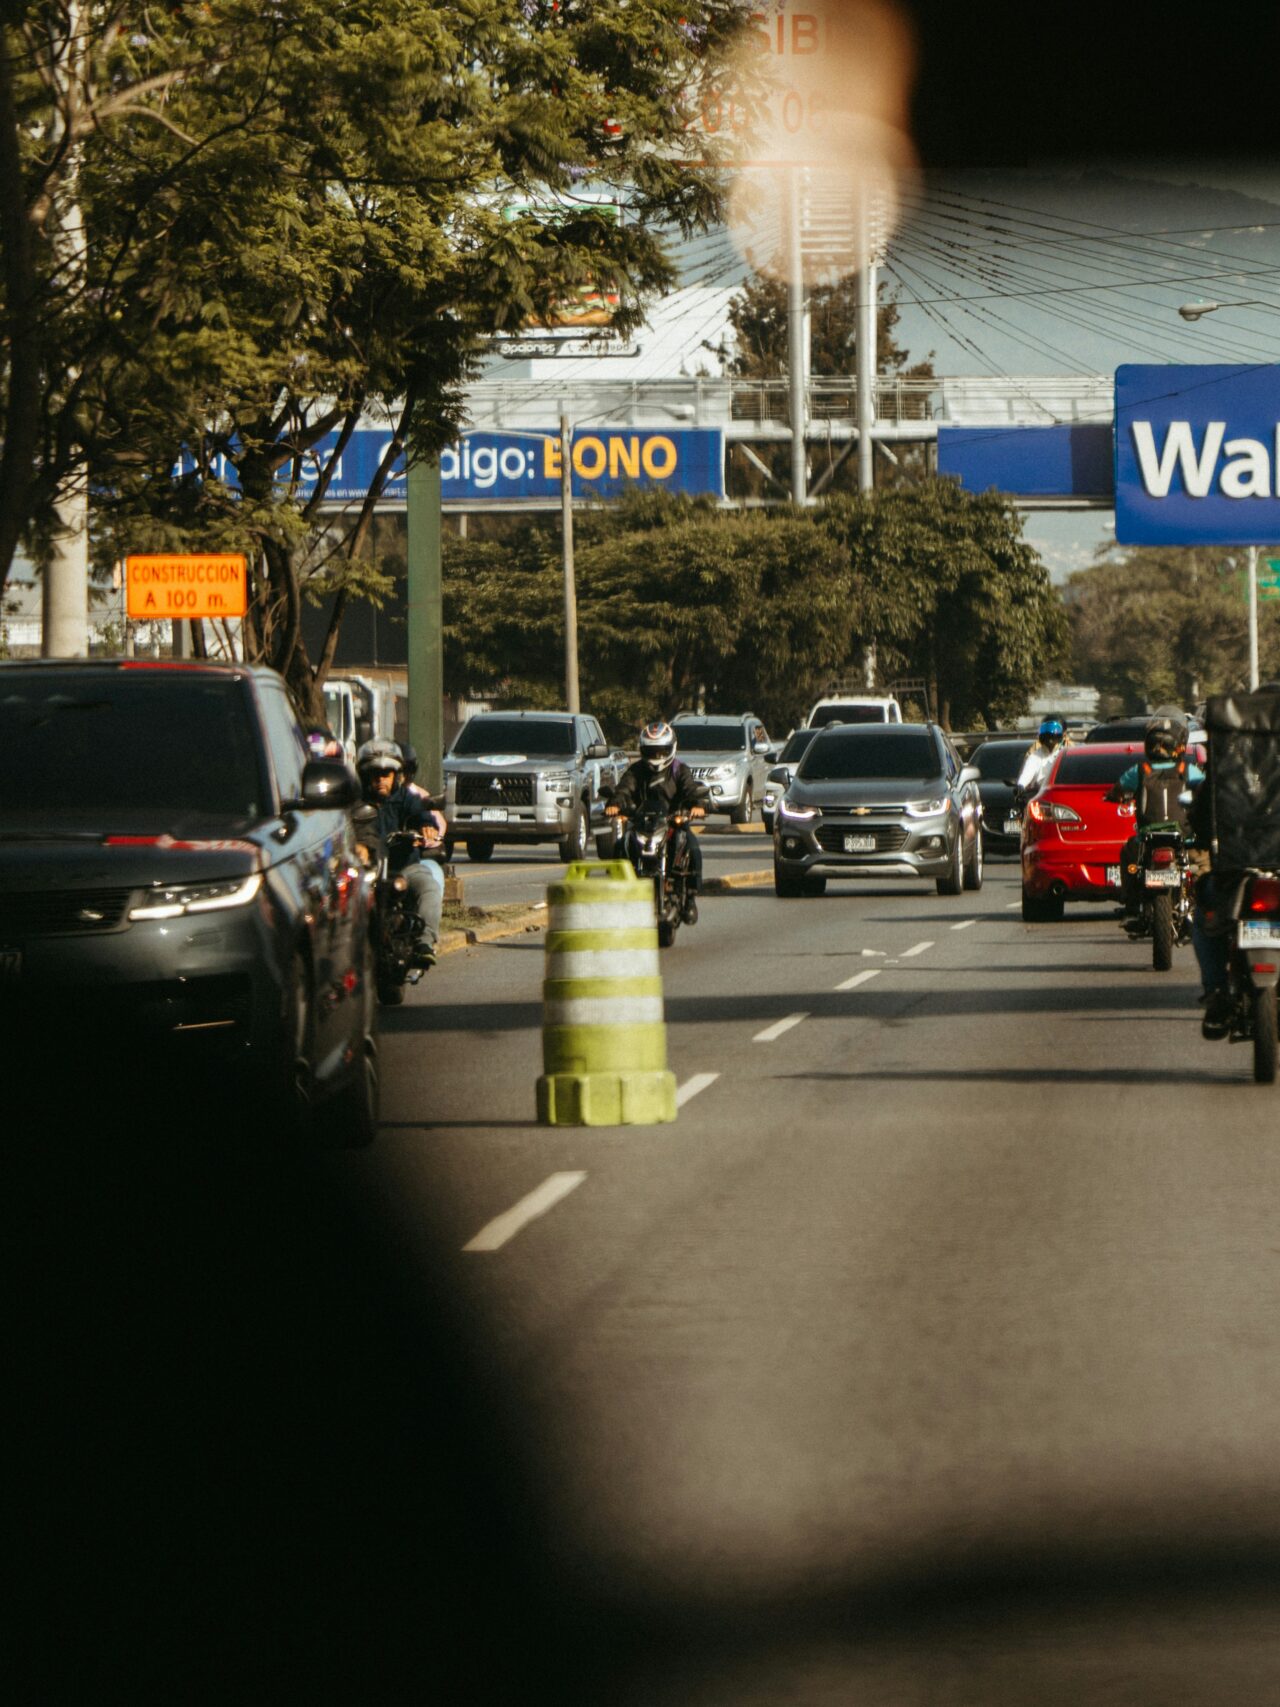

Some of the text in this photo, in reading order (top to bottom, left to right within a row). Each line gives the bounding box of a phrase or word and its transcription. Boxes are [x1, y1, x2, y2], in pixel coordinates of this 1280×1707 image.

[378, 438, 535, 489] Cdigo:
[544, 436, 678, 480] BONO
[132, 563, 239, 584] CONSTRUCCION
[145, 591, 157, 608] A
[167, 590, 197, 609] 100
